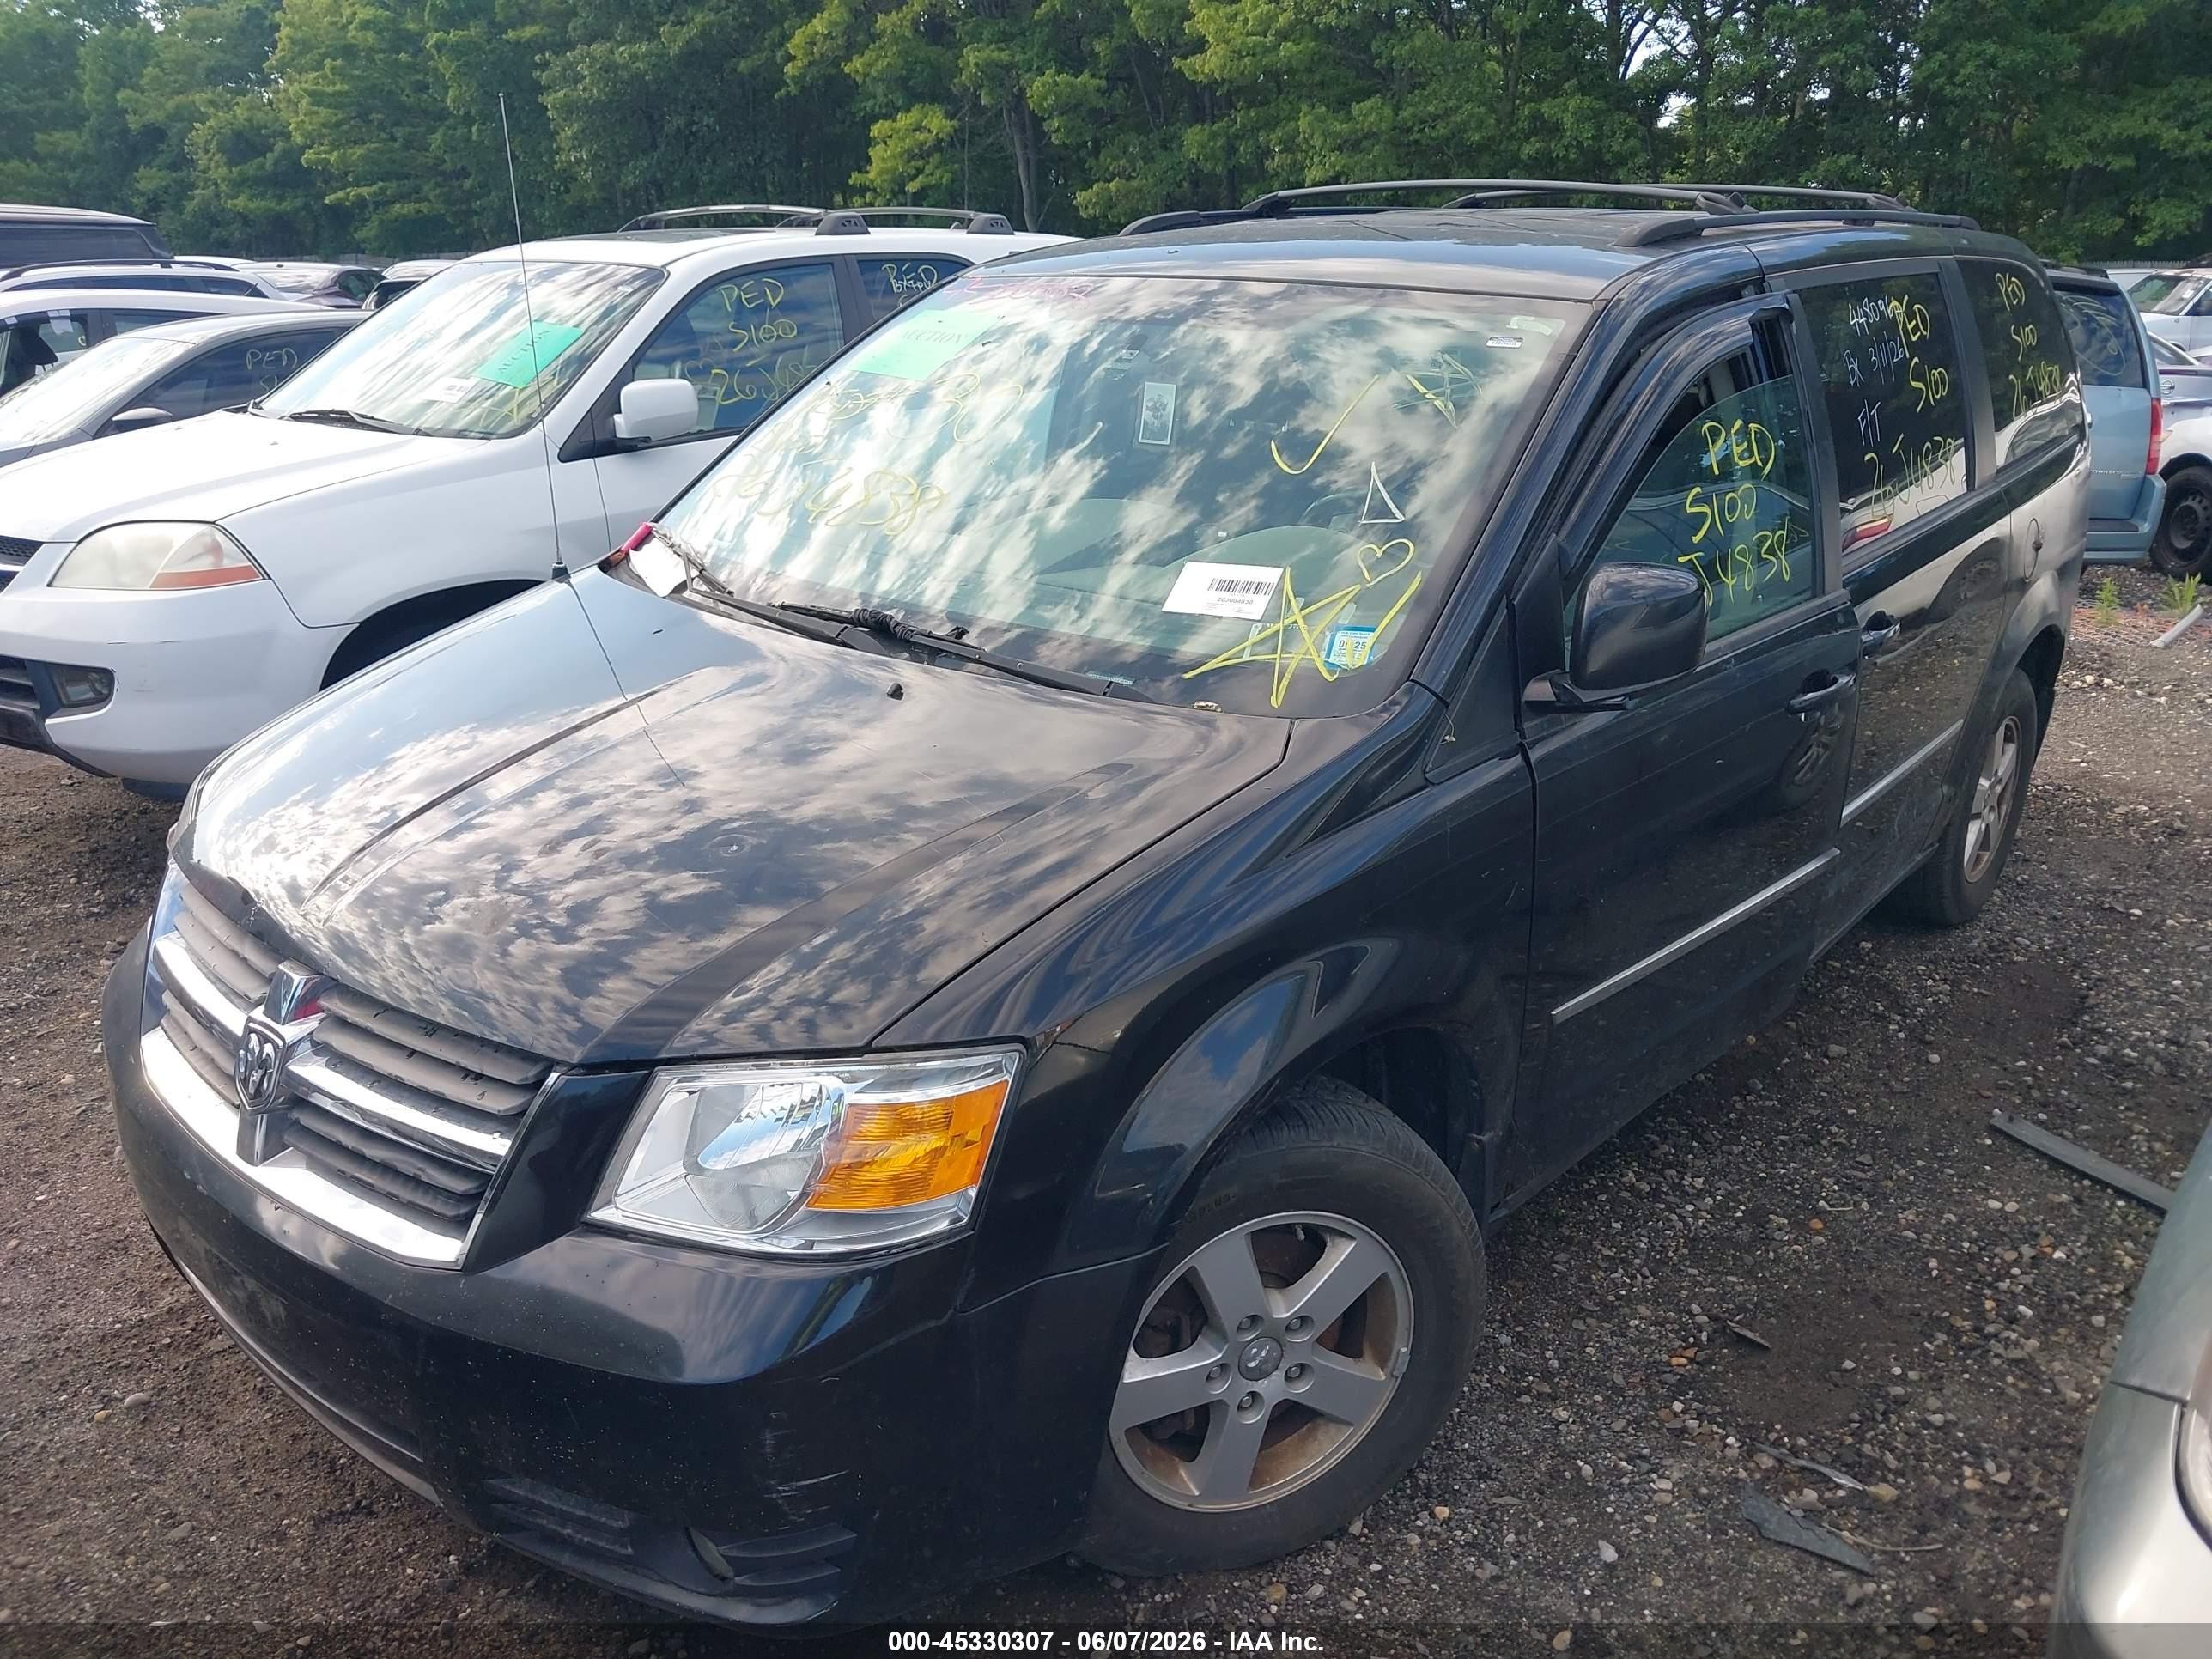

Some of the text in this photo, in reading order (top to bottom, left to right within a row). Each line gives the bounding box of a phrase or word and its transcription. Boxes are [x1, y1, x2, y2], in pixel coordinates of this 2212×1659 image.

[715, 277, 785, 312] PED
[1995, 272, 2026, 312] PED
[728, 319, 798, 353] S100
[2010, 324, 2038, 362] S100
[246, 347, 298, 370] PED
[1909, 356, 1948, 413] S100
[1701, 418, 1776, 482] PED
[1686, 483, 1758, 544] S100
